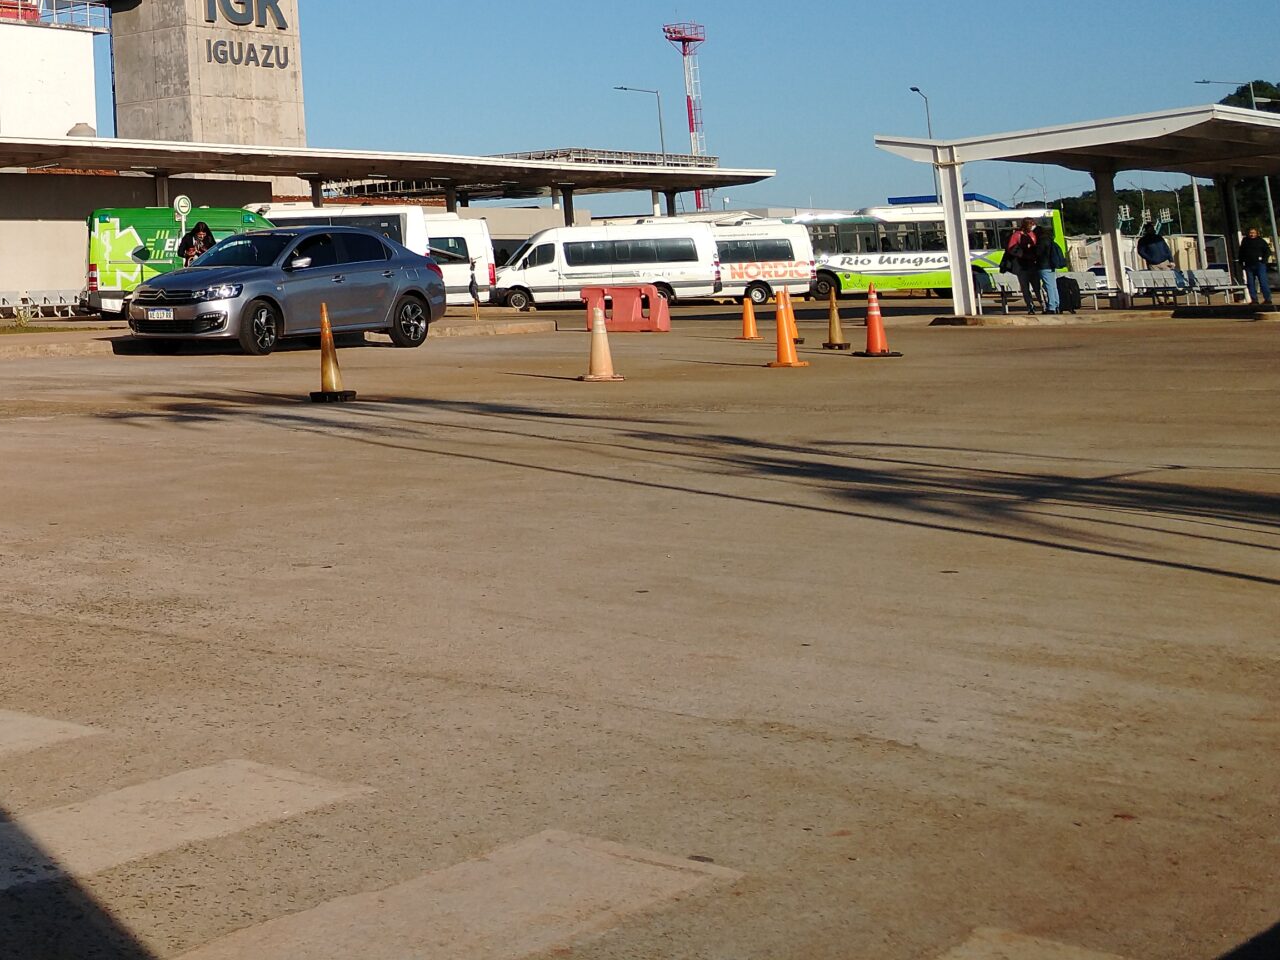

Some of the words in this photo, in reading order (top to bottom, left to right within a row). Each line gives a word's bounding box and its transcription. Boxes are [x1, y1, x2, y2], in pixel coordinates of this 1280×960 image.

[205, 38, 289, 69] IGUAZU
[730, 261, 809, 279] NORDIC
[878, 254, 950, 269] Urugua
